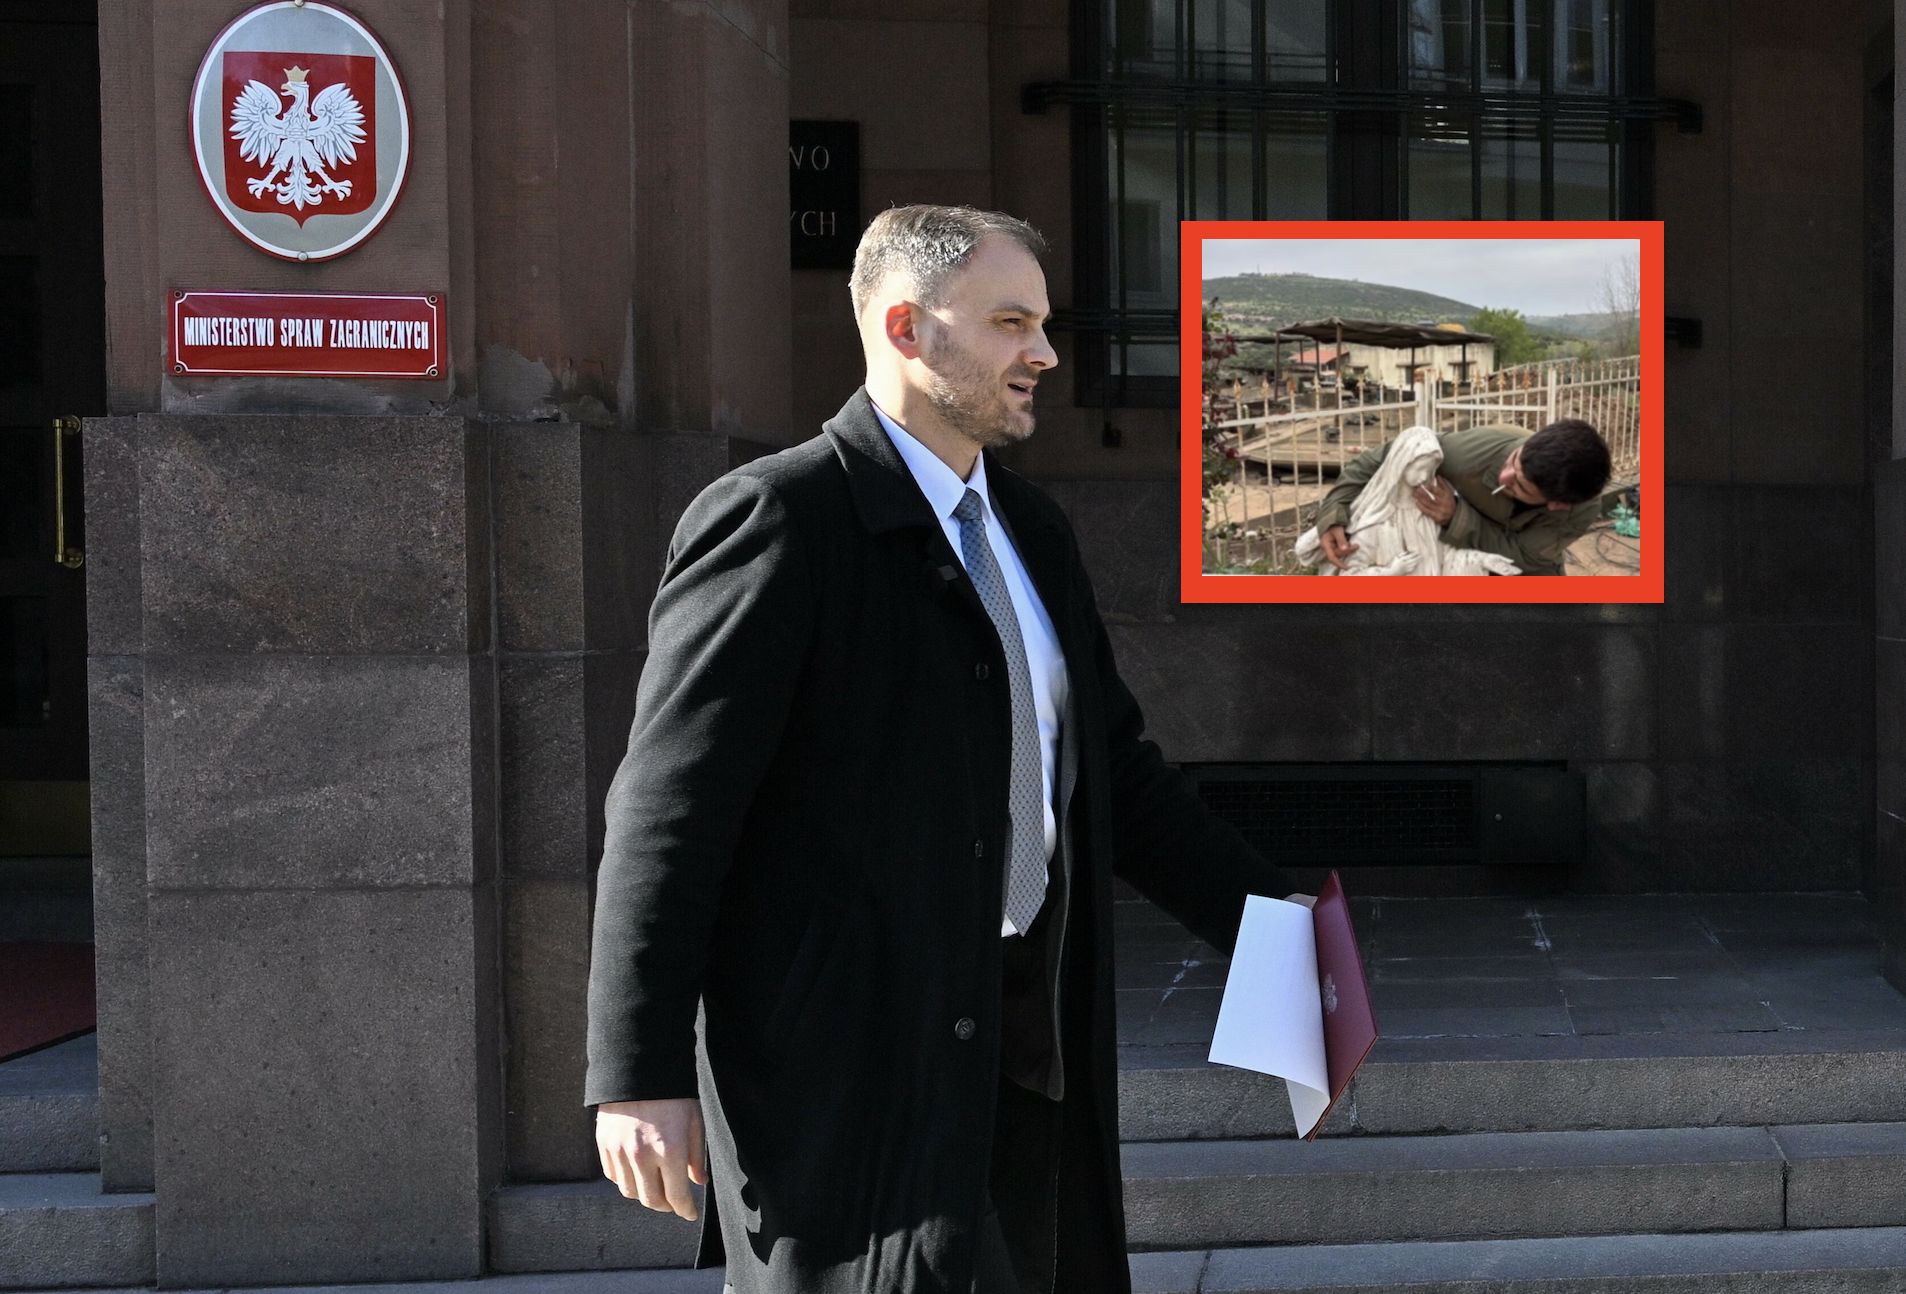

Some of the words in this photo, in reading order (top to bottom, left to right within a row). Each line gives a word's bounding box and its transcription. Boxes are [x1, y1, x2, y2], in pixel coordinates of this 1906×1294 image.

[790, 211, 836, 236] CH
[184, 316, 275, 347] MINISTERSTWO
[280, 318, 323, 348] SPRAW
[329, 319, 429, 350] ZAGRANICZNYCH
